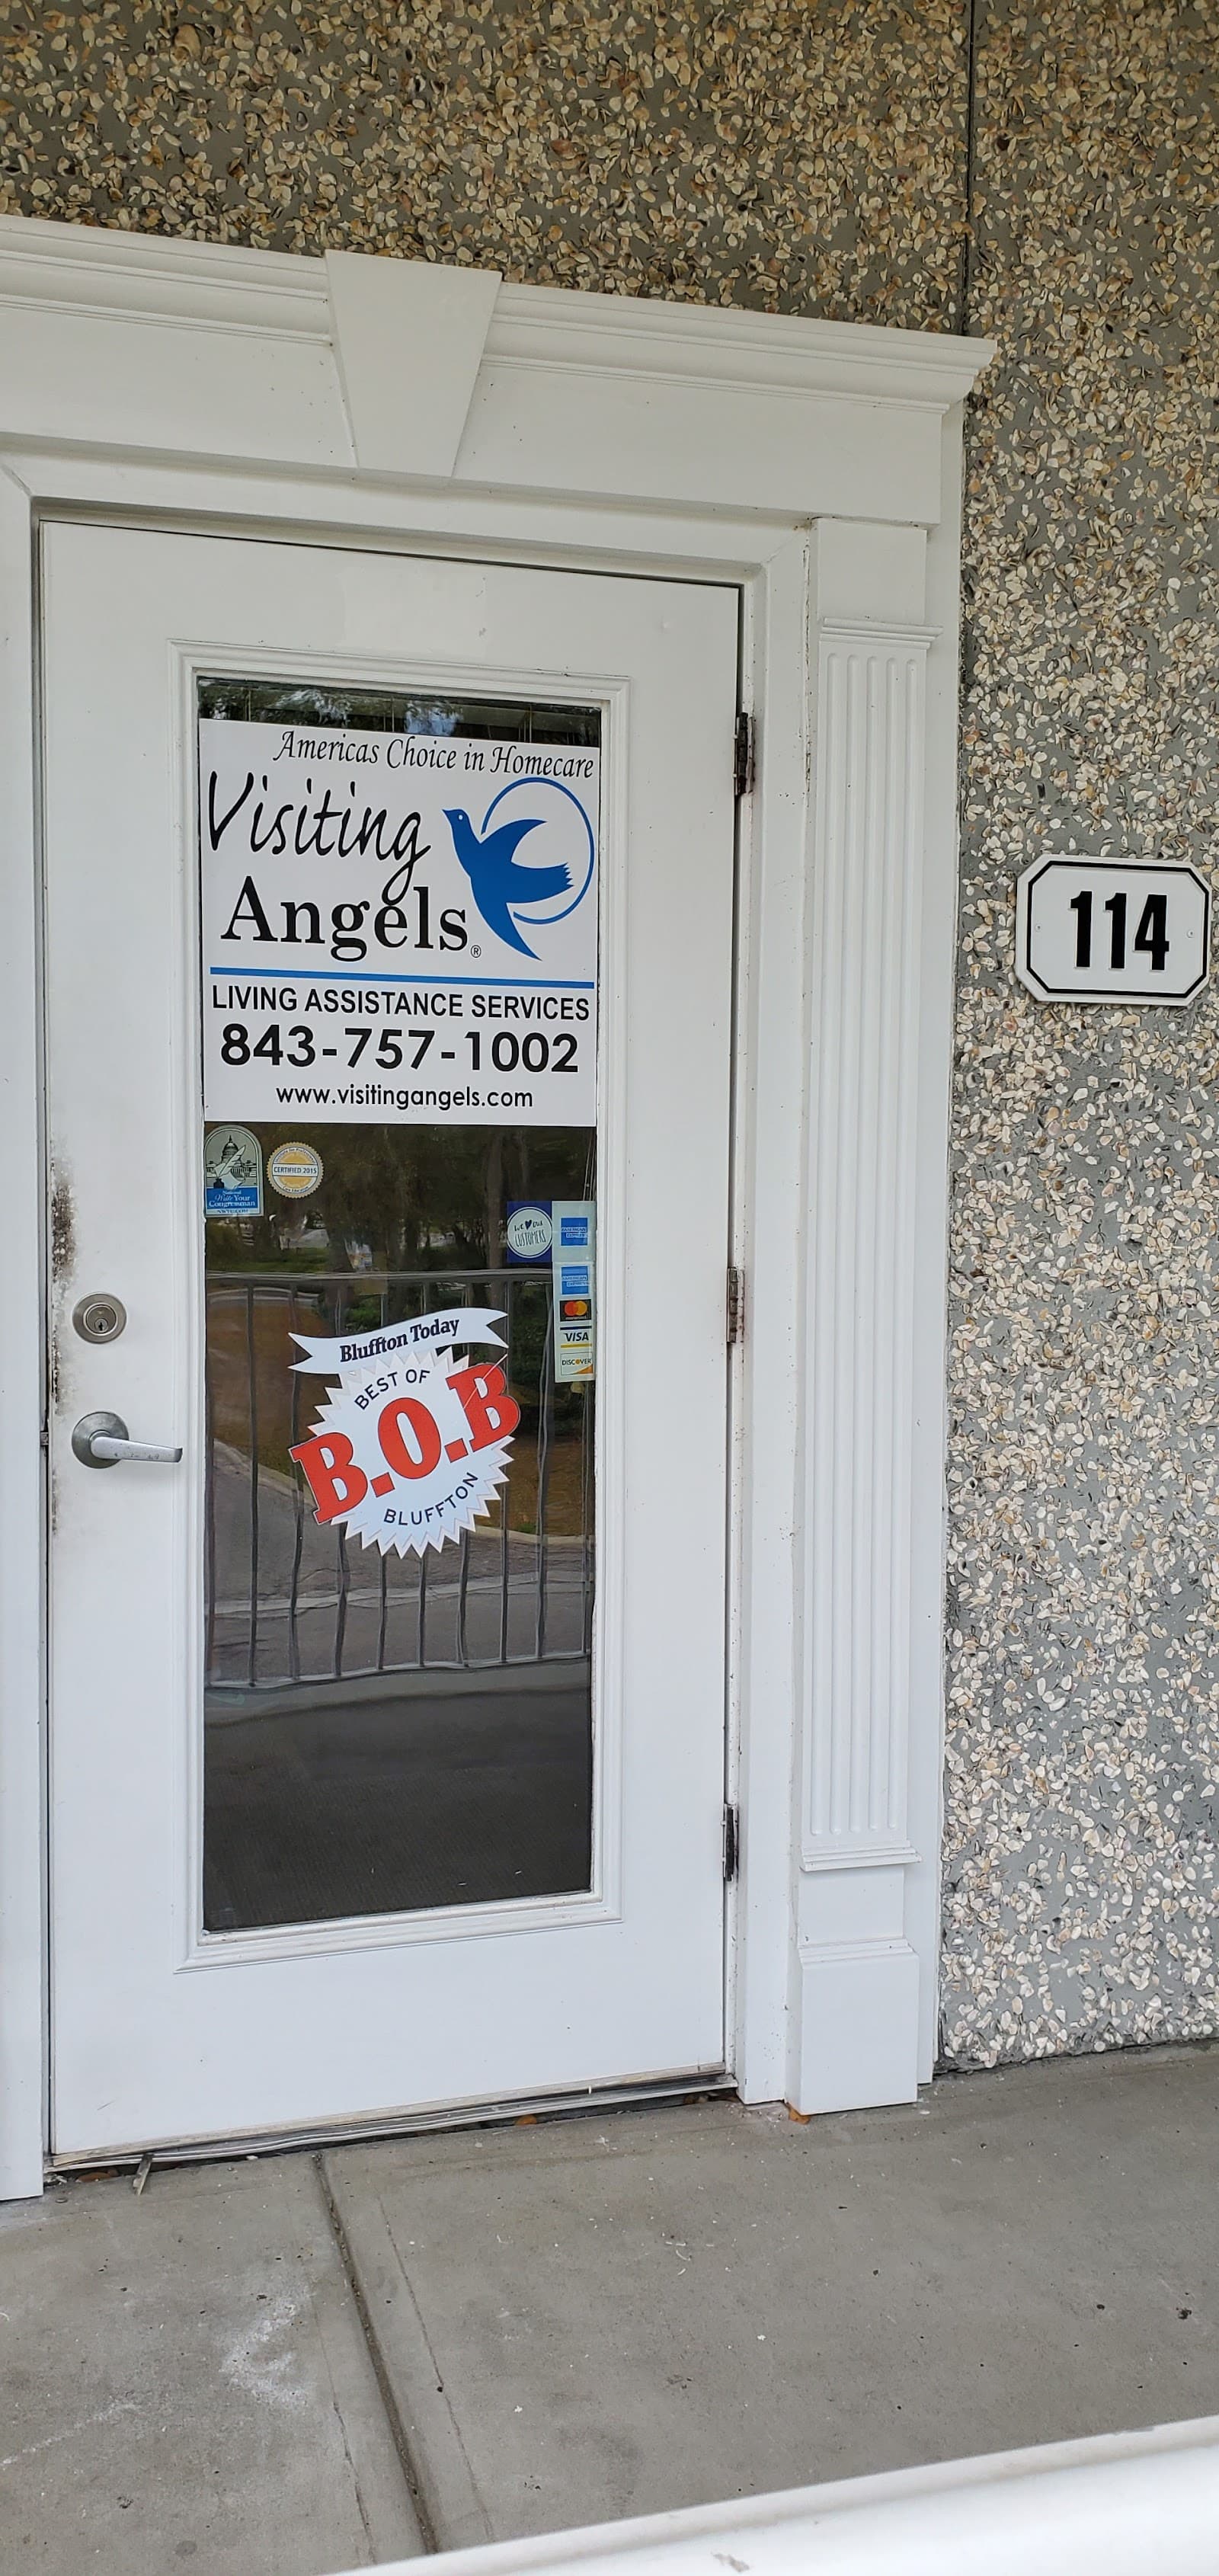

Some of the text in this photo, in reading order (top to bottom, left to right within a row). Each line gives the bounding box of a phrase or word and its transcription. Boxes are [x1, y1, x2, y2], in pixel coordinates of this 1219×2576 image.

[272, 730, 594, 779] Americas Choice in Homecare
[208, 770, 432, 906] Visiting
[1070, 890, 1170, 971] 114
[213, 984, 590, 1021] LIVING ASSISTANCE SERVICES
[220, 1022, 579, 1074] 843-757-1002
[276, 1083, 533, 1111] www.visitingangels.com
[514, 1228, 547, 1248] CUSTOMERS
[340, 1318, 460, 1362] Bluffton Today
[563, 1332, 589, 1342] VISA
[562, 1358, 592, 1366] DISCOVER
[354, 1368, 430, 1410] BEST OF
[290, 1362, 521, 1525] B.O.B
[383, 1471, 478, 1525] BLUFFTON
